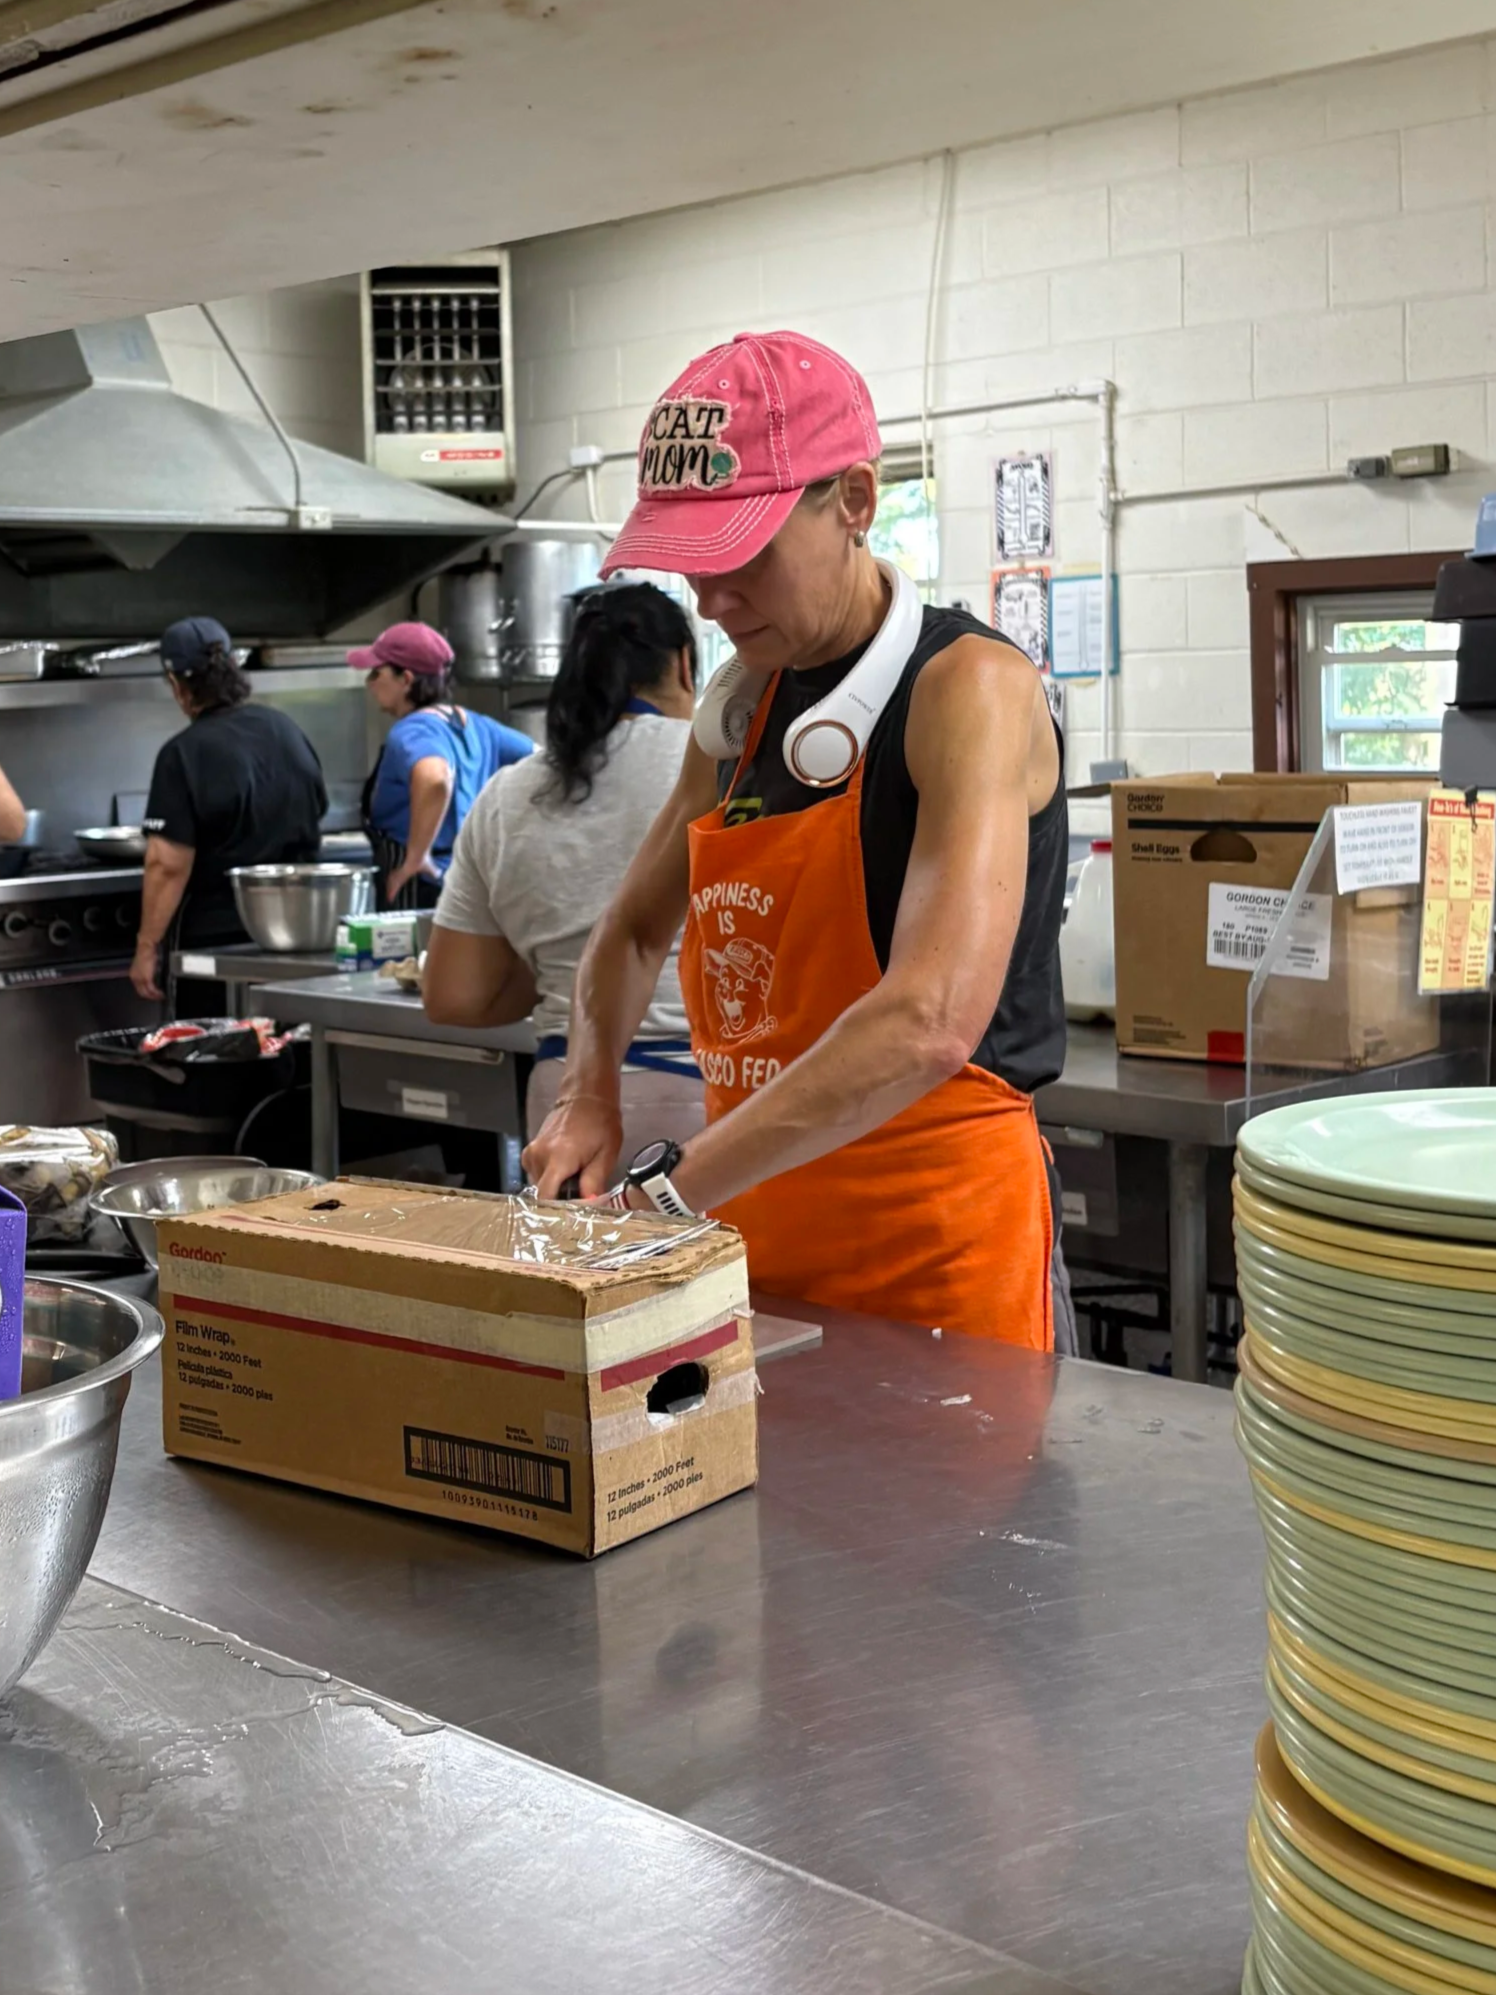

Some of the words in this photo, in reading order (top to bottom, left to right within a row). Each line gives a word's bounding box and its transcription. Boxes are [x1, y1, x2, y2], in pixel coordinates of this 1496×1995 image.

[652, 406, 724, 440] CAT
[1131, 843, 1154, 853] Shell
[1156, 843, 1180, 855] Eggs
[692, 881, 774, 917] APPINESS
[1226, 892, 1271, 907] GORDON
[717, 911, 736, 935] IS
[175, 1320, 198, 1338] Film
[200, 1324, 230, 1346] Wrap
[177, 1341, 186, 1353] 12
[219, 1350, 241, 1364] 2000
[243, 1355, 262, 1369] Feet
[178, 1371, 187, 1383] 12
[188, 1375, 224, 1391] pulgadas
[232, 1383, 254, 1397] 2000
[256, 1389, 273, 1402] pies
[607, 1491, 617, 1505] 12
[652, 1465, 674, 1483] 2000
[675, 1456, 694, 1473] Feet
[607, 1509, 617, 1523] 12
[618, 1492, 655, 1520] pulgadas
[663, 1477, 685, 1497] 2000
[686, 1471, 703, 1488] pies
